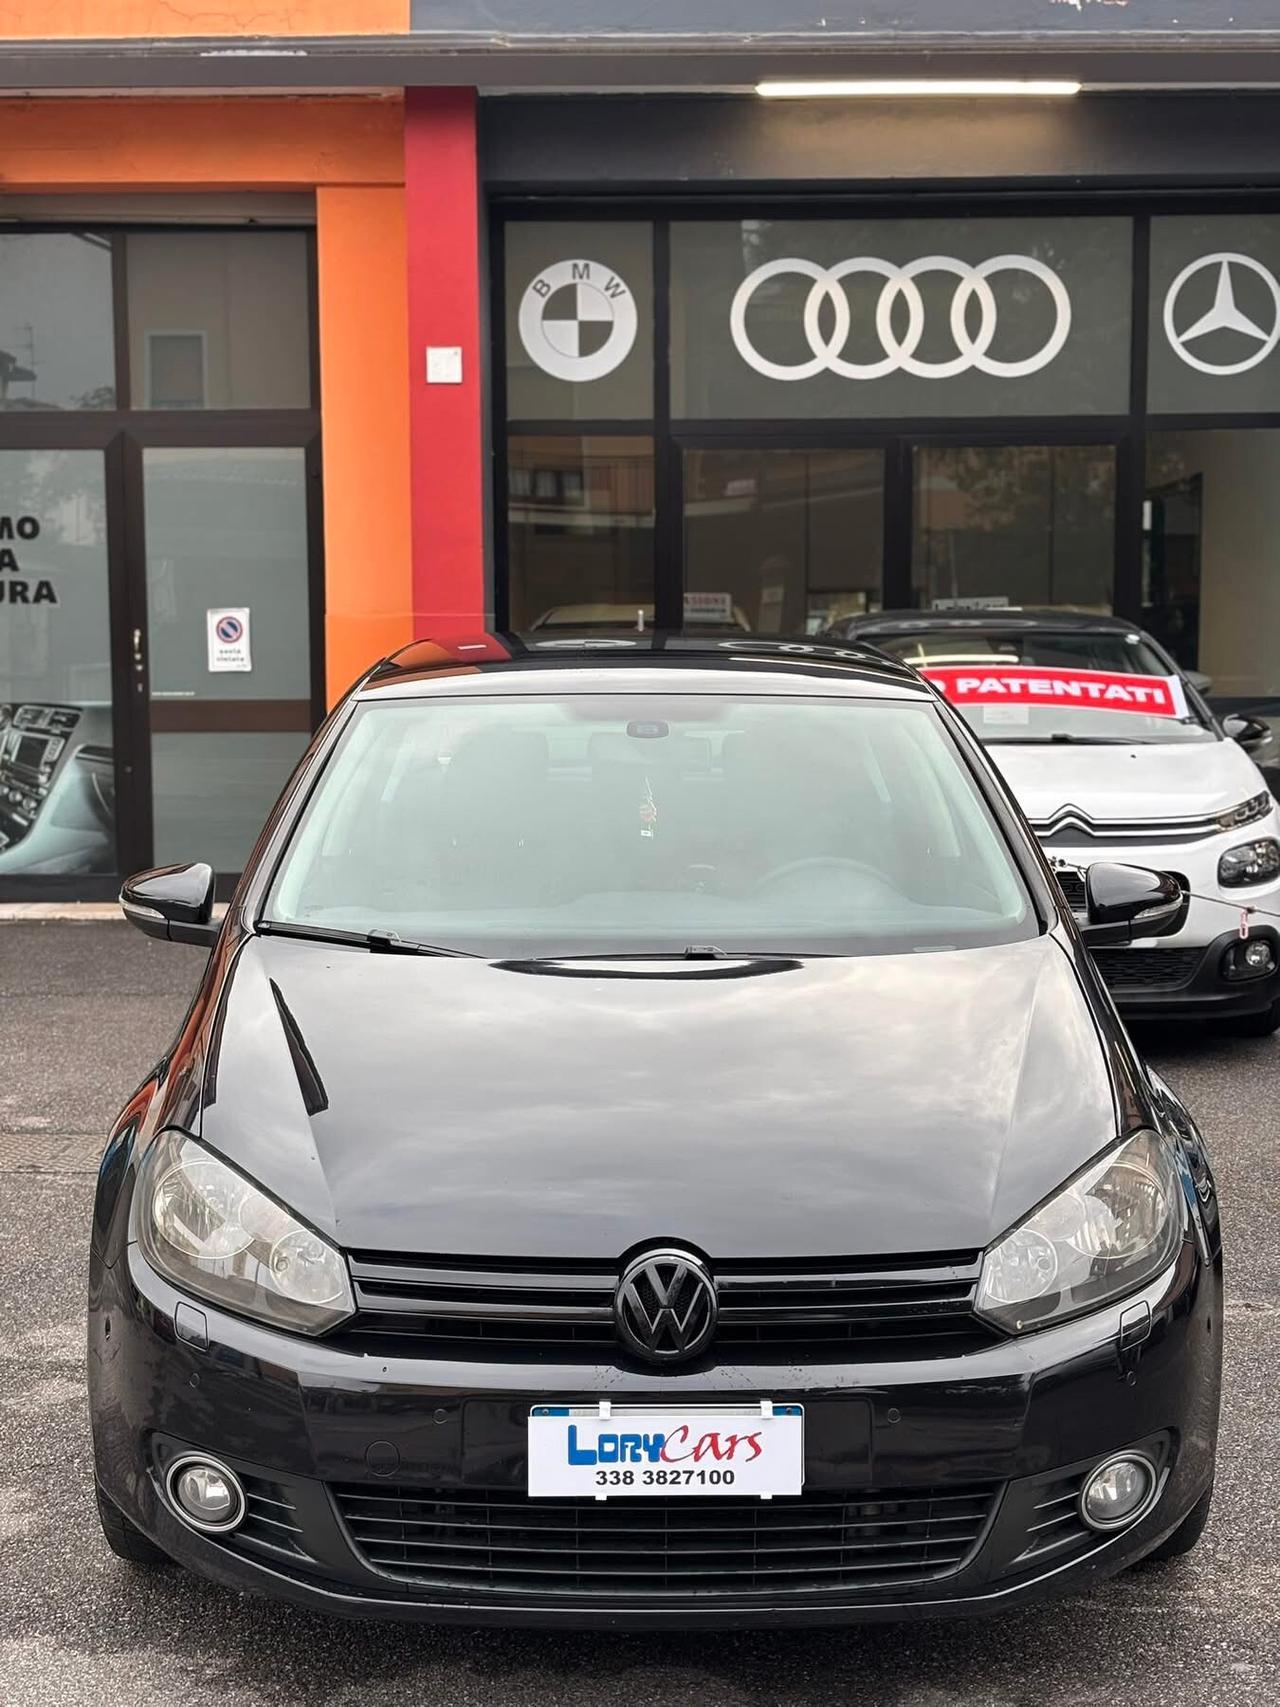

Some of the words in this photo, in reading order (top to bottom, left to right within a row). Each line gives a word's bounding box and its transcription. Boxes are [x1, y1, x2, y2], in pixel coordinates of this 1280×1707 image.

[532, 262, 626, 298] BMW
[0, 580, 58, 604] RA
[956, 677, 1166, 705] PATENTATI
[595, 1470, 635, 1486] 338
[642, 1469, 736, 1486] 3827100
